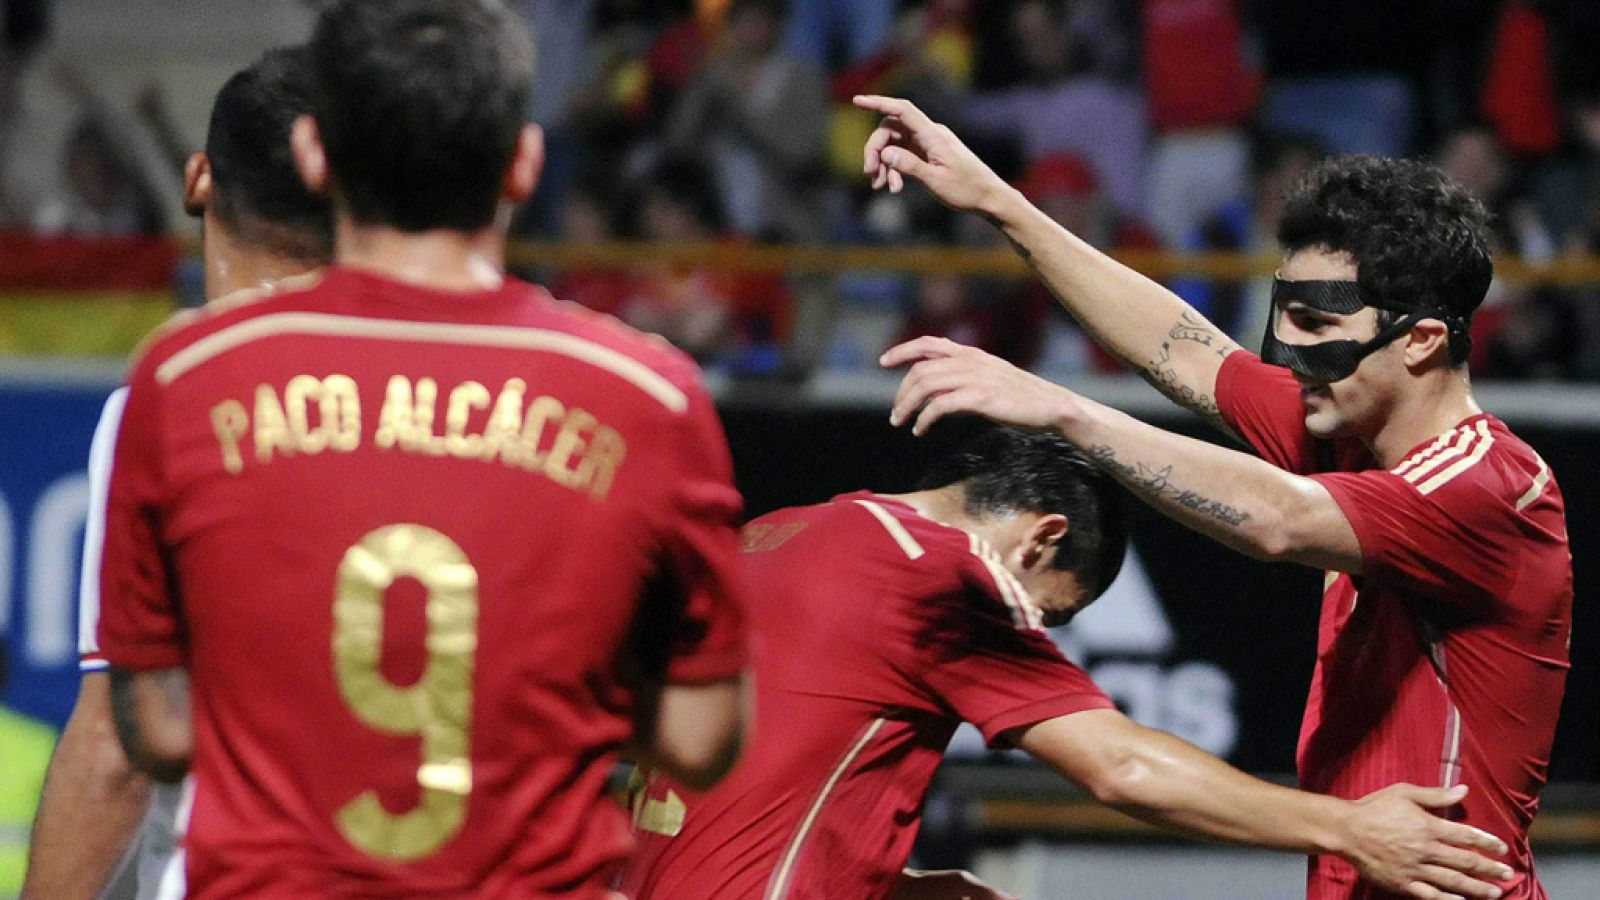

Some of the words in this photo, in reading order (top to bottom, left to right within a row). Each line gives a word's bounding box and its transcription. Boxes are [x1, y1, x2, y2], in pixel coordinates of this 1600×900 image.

[211, 374, 361, 473] PACO
[375, 374, 627, 501] ALCÁCER
[333, 523, 478, 859] 9
